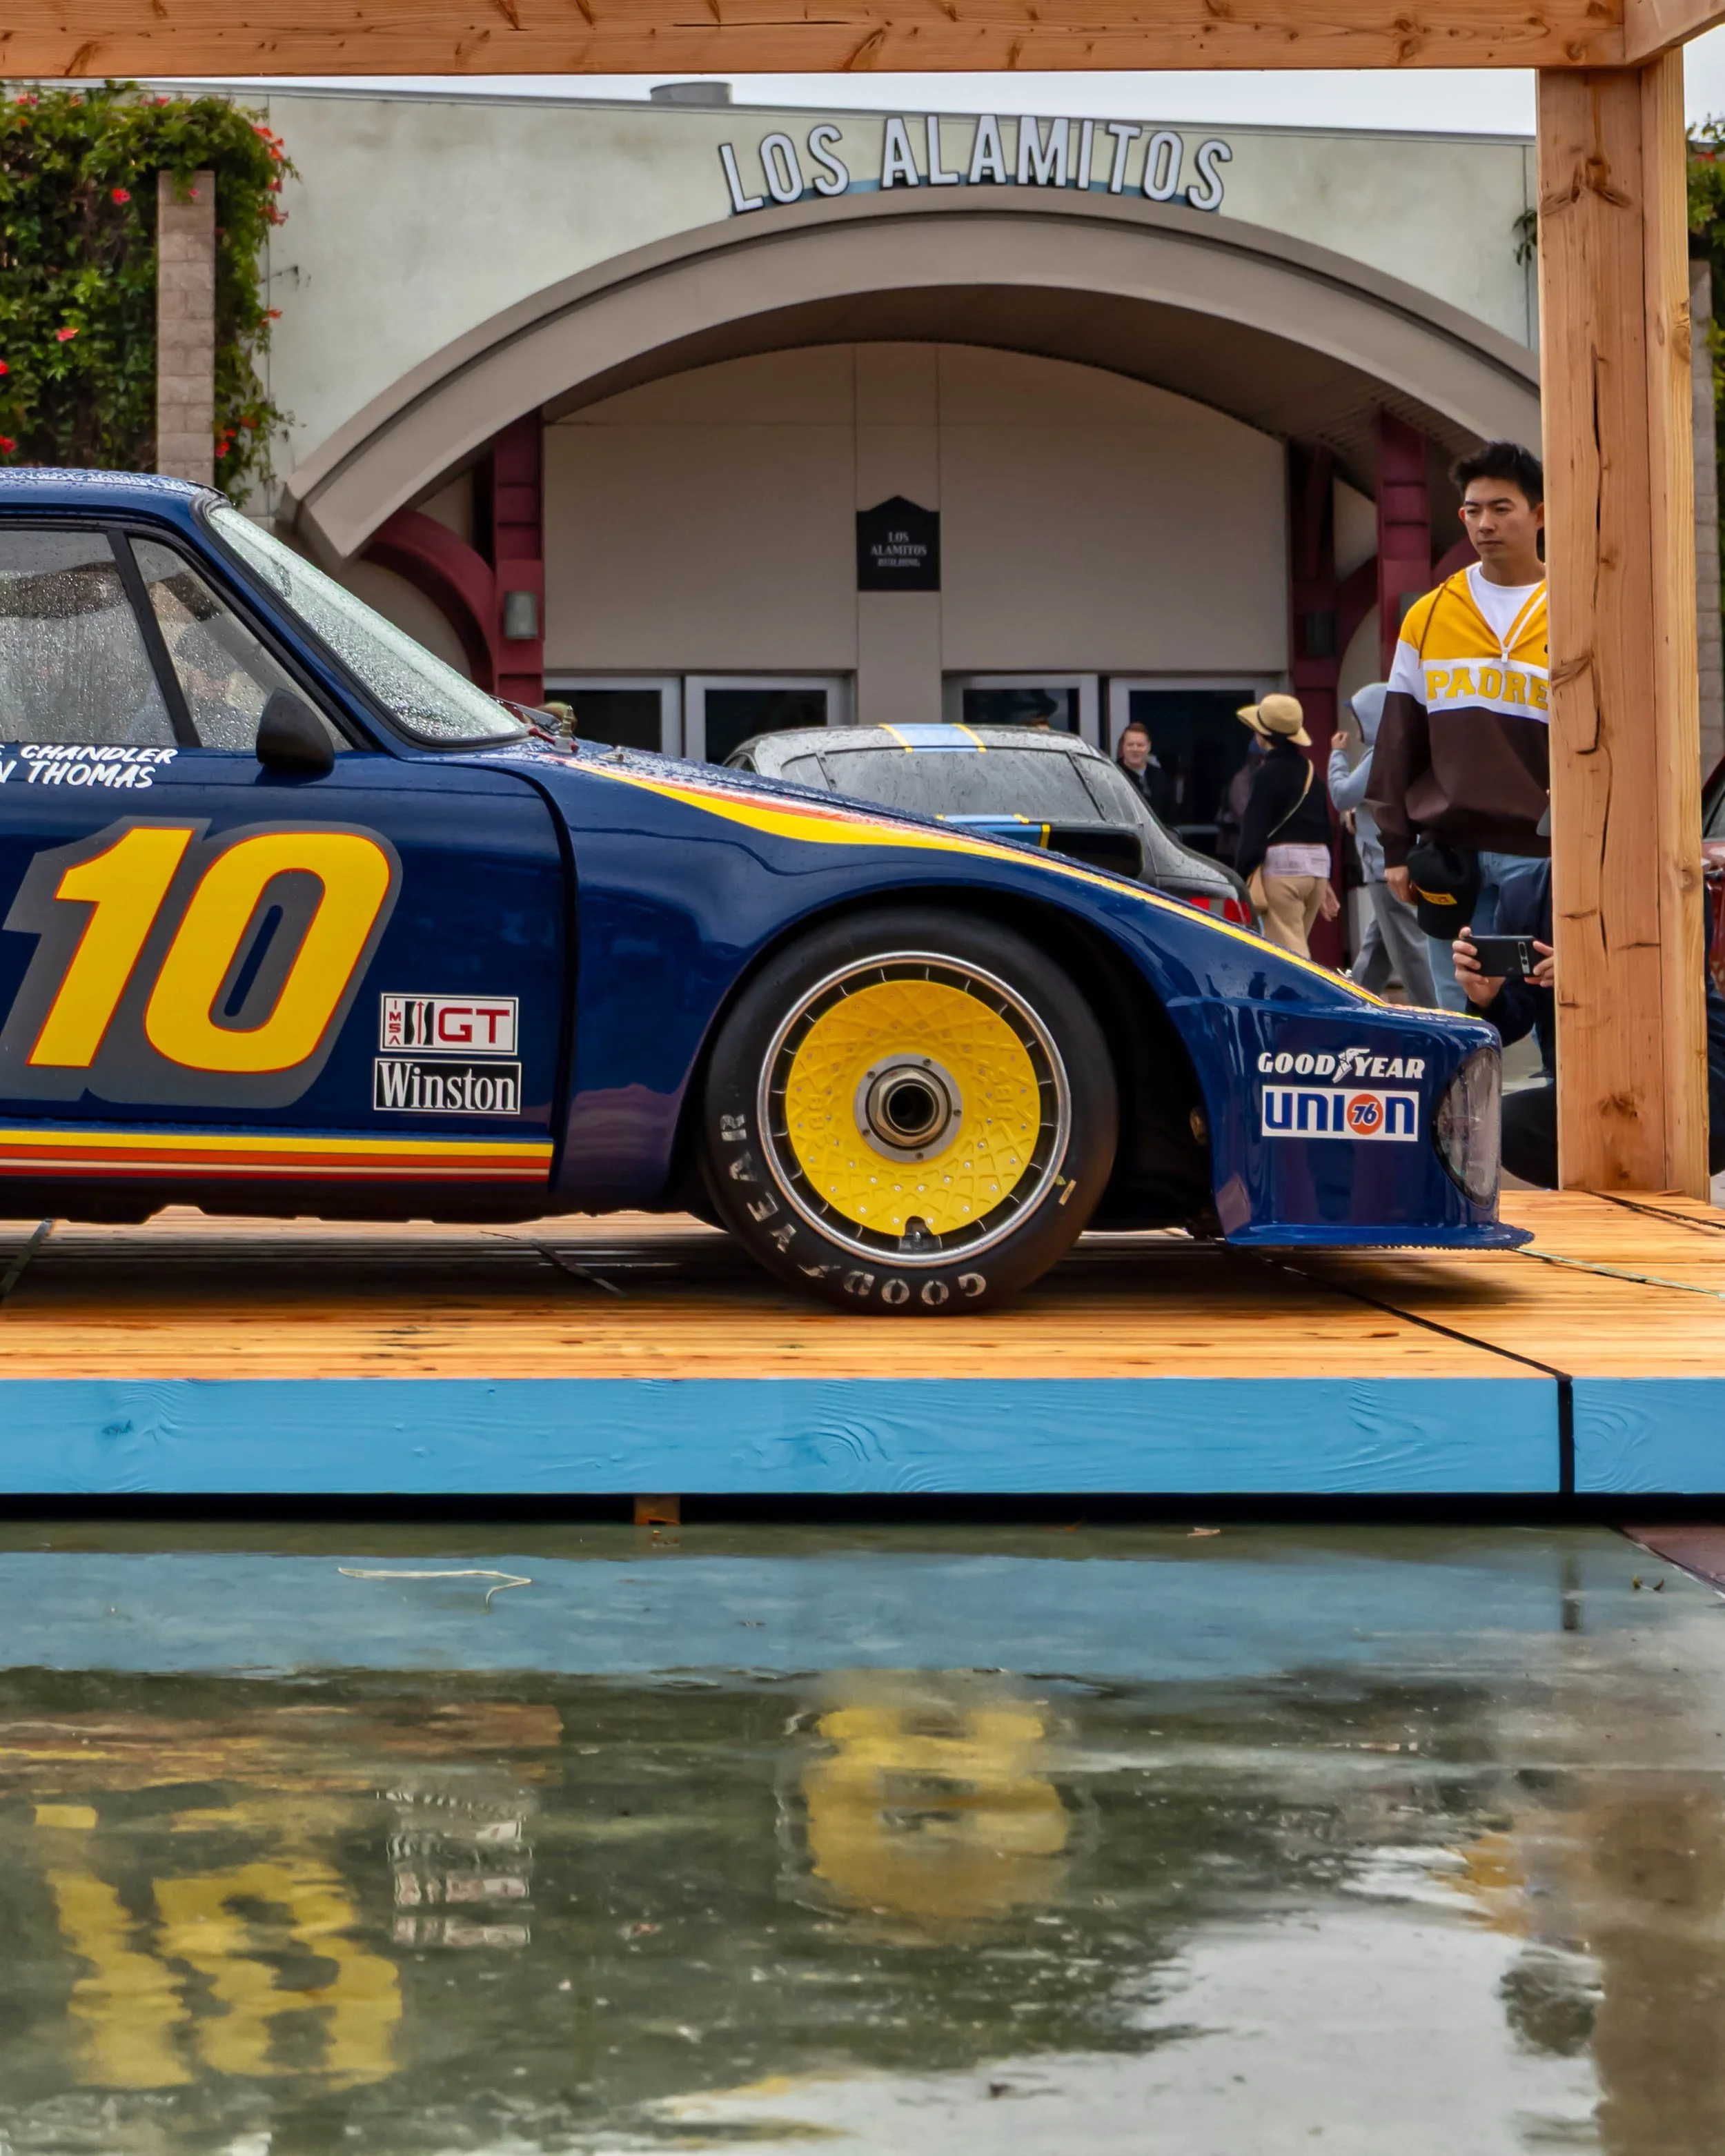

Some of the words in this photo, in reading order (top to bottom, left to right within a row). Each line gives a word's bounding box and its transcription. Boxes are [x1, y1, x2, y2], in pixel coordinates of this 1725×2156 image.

[719, 124, 851, 215] LOS
[880, 114, 1233, 211] ALAMITOS
[871, 544, 927, 556] ALAMITOS
[888, 532, 909, 543] LOS
[20, 744, 179, 764] CHANDLER
[28, 760, 156, 789] THOMAS
[25, 826, 392, 1074] 10
[438, 1007, 511, 1044] GT
[379, 1062, 516, 1110] Winston
[1352, 1103, 1379, 1126] 76
